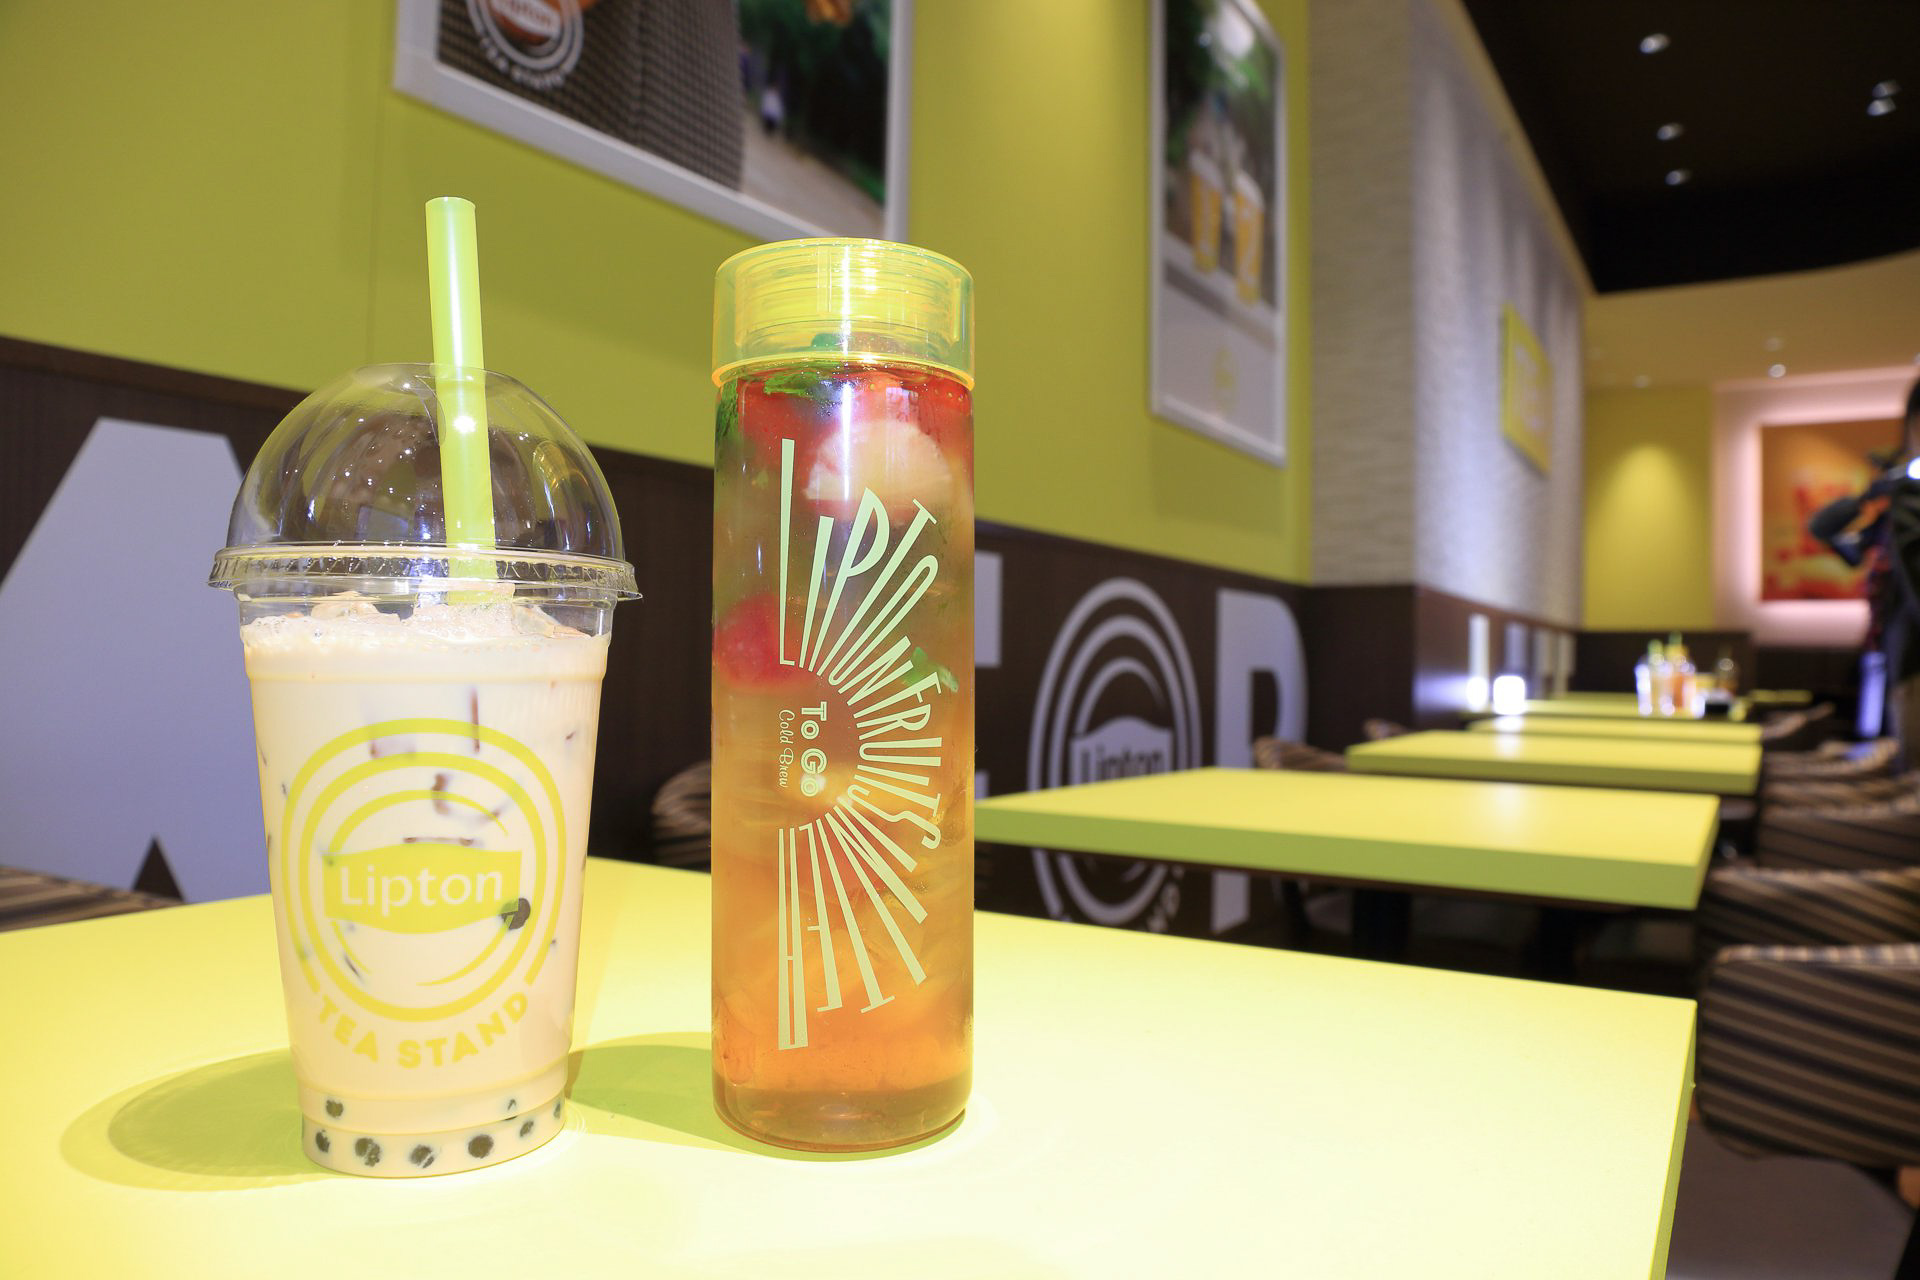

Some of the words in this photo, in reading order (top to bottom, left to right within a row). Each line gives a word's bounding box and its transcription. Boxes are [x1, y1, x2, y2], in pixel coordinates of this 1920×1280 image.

[779, 438, 939, 706] LIPTON
[778, 709, 796, 745] Cold
[778, 747, 794, 789] Brew
[846, 671, 943, 850] FRUITS
[340, 864, 502, 917] Lipton
[777, 817, 896, 1051] TEA
[824, 797, 928, 986] IN
[318, 994, 379, 1064] TEA
[397, 991, 528, 1069] STAND
